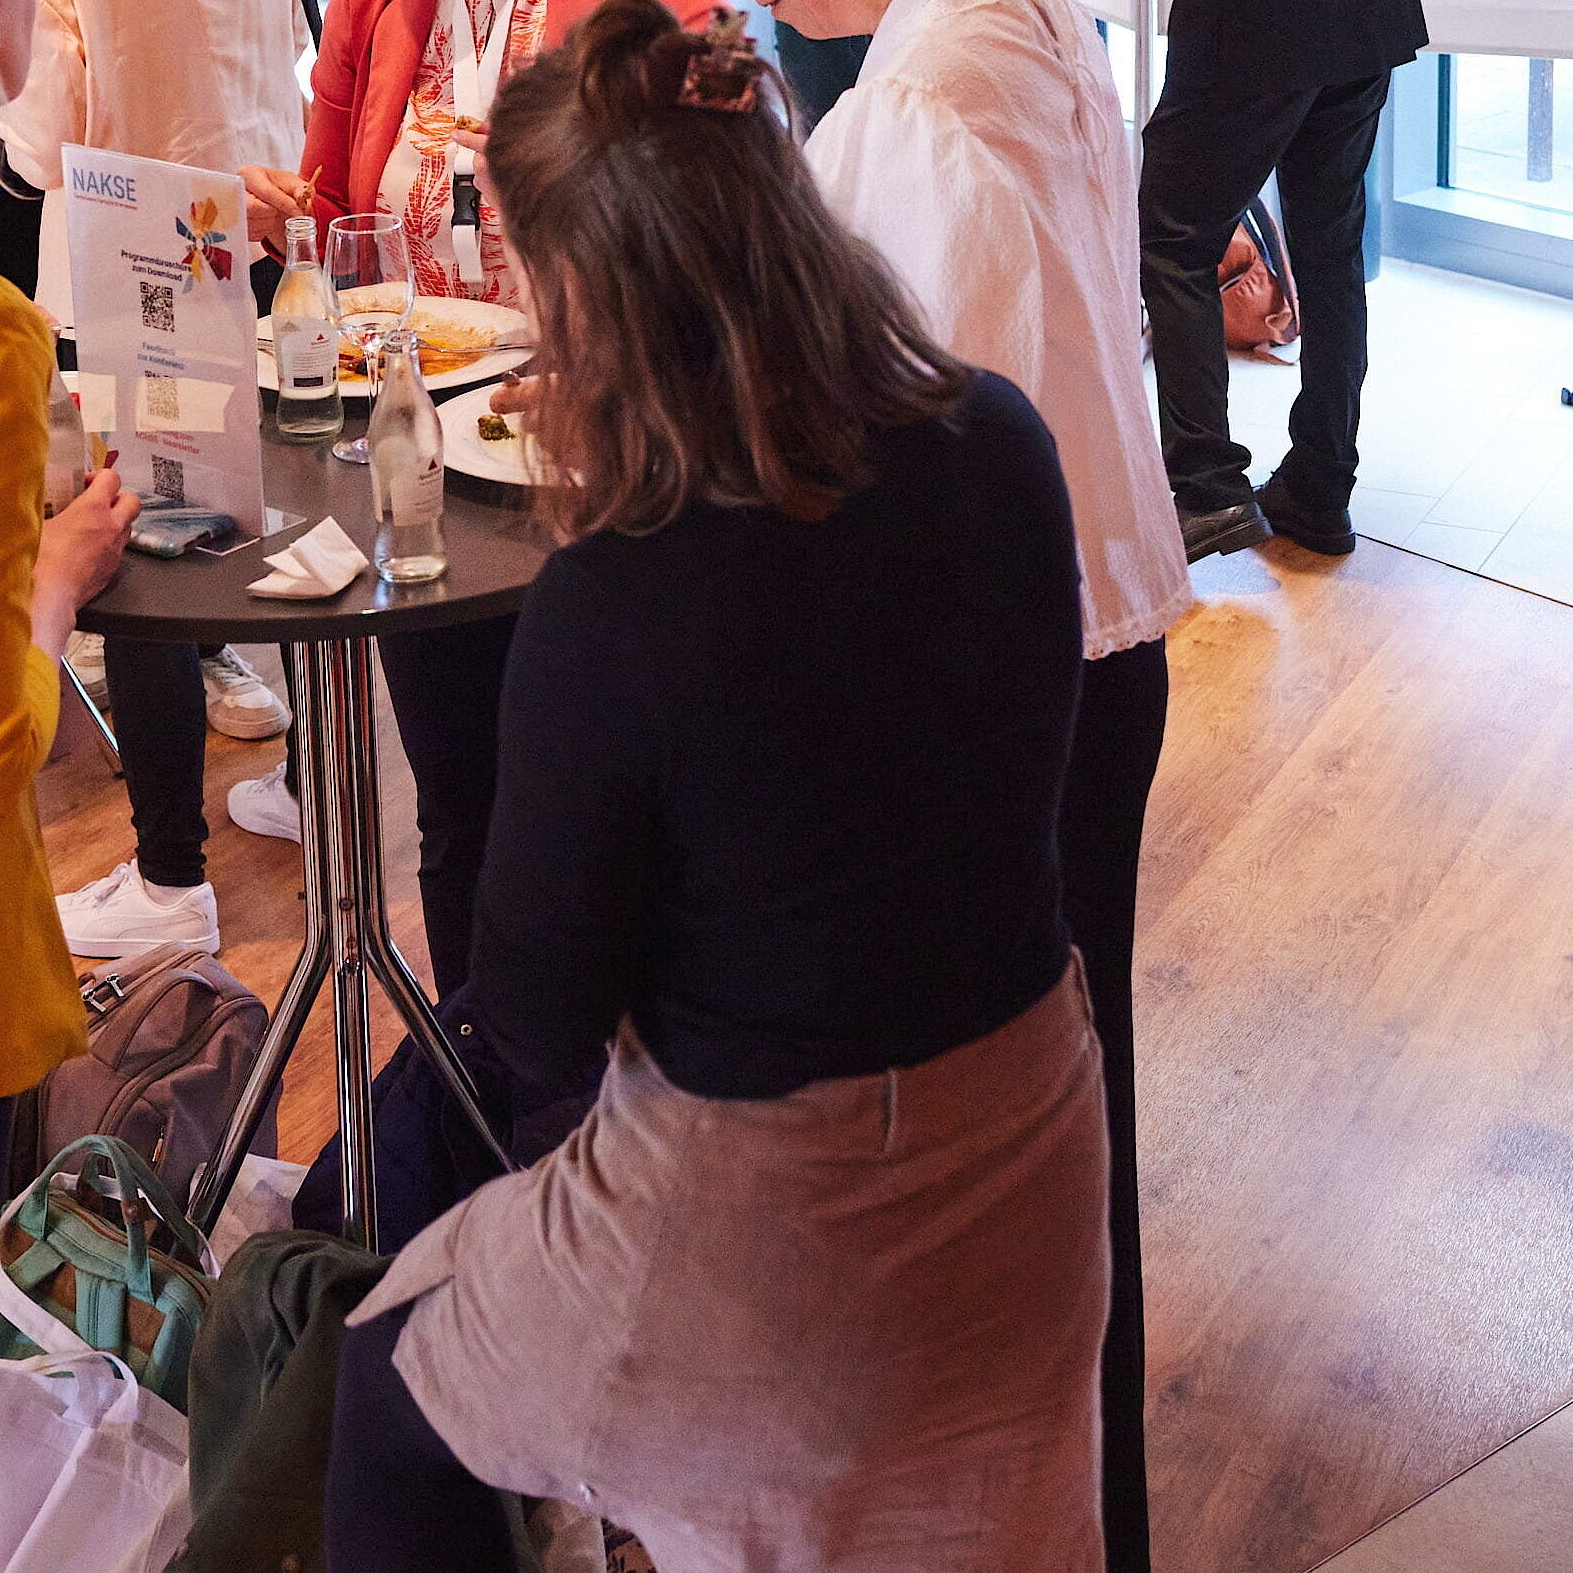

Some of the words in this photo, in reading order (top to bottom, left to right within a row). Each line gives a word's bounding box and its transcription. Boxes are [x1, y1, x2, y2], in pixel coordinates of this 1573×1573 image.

[73, 168, 137, 202] NAKSE
[132, 265, 146, 273] zum
[148, 268, 182, 281] Download
